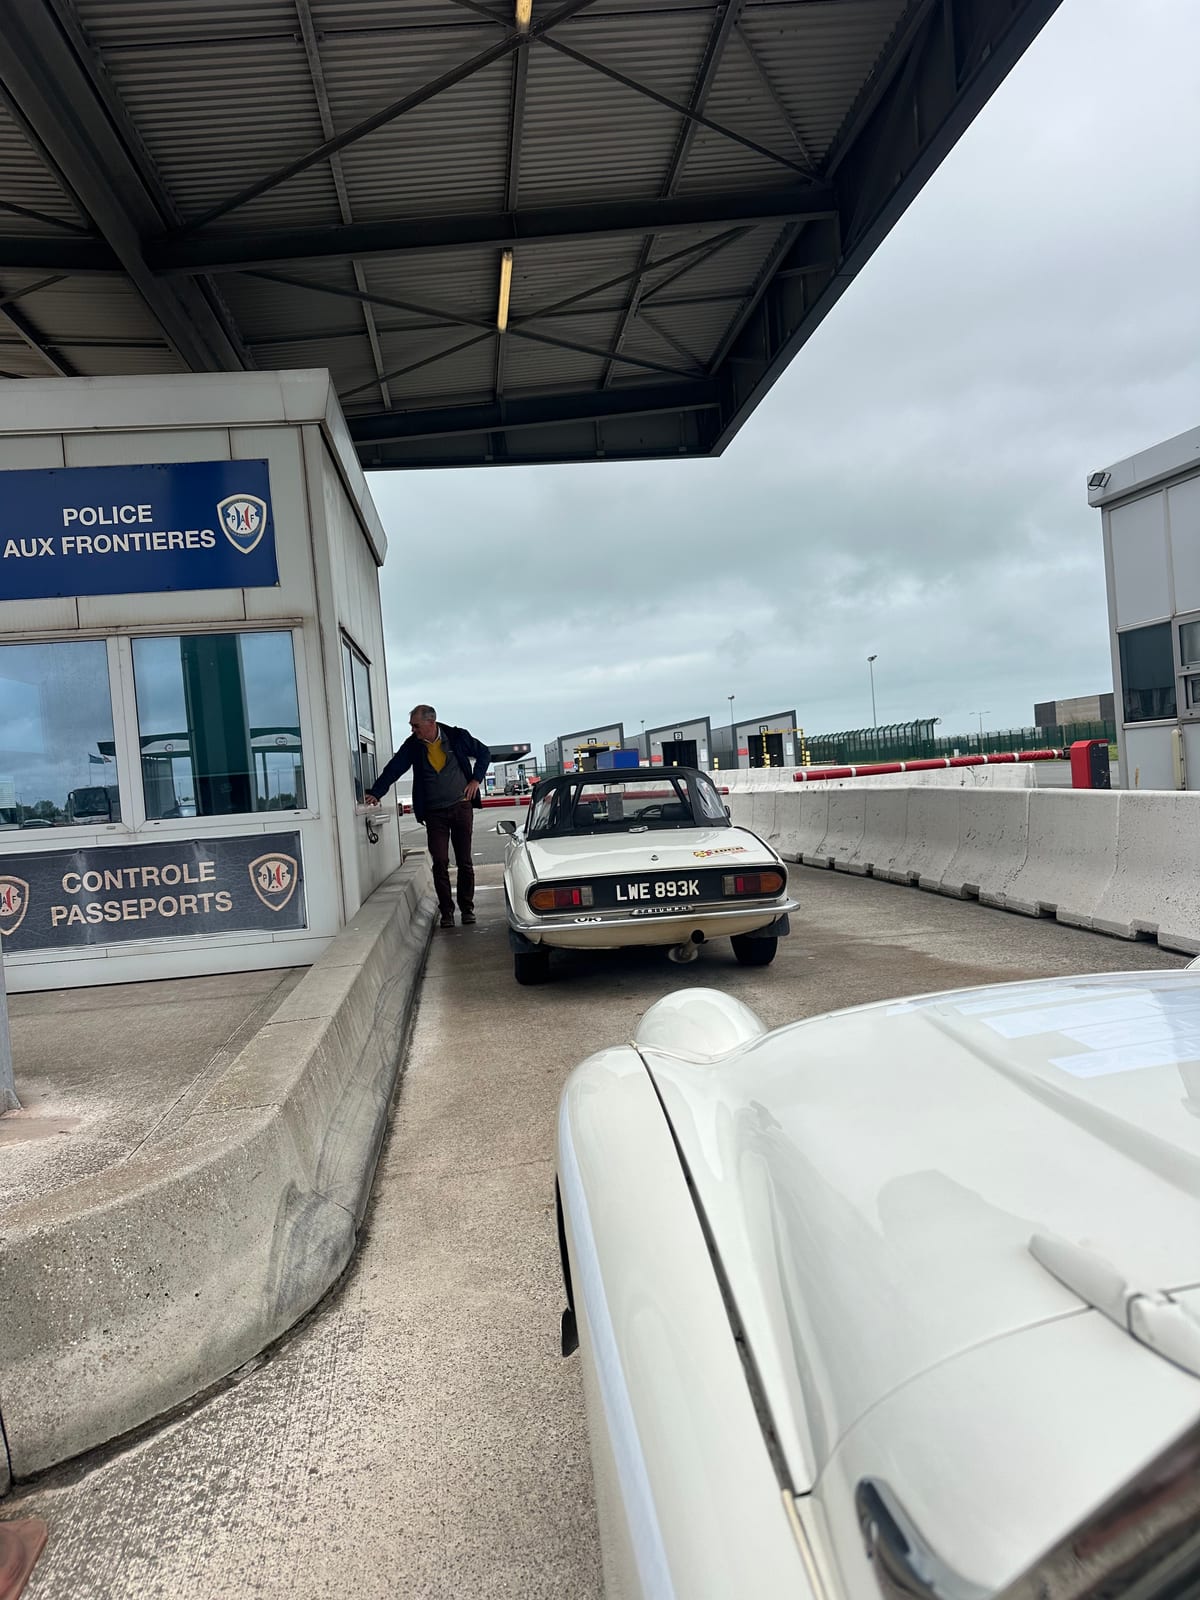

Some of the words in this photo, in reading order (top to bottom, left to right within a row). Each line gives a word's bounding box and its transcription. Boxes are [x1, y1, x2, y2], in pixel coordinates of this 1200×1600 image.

[62, 504, 153, 527] POLICE
[3, 537, 56, 558] AUX
[61, 529, 216, 555] FRONTIERES
[61, 861, 217, 894] CONTROLE
[615, 882, 651, 901] LWE
[654, 879, 700, 898] 893K
[50, 890, 233, 927] PASSEPORTS
